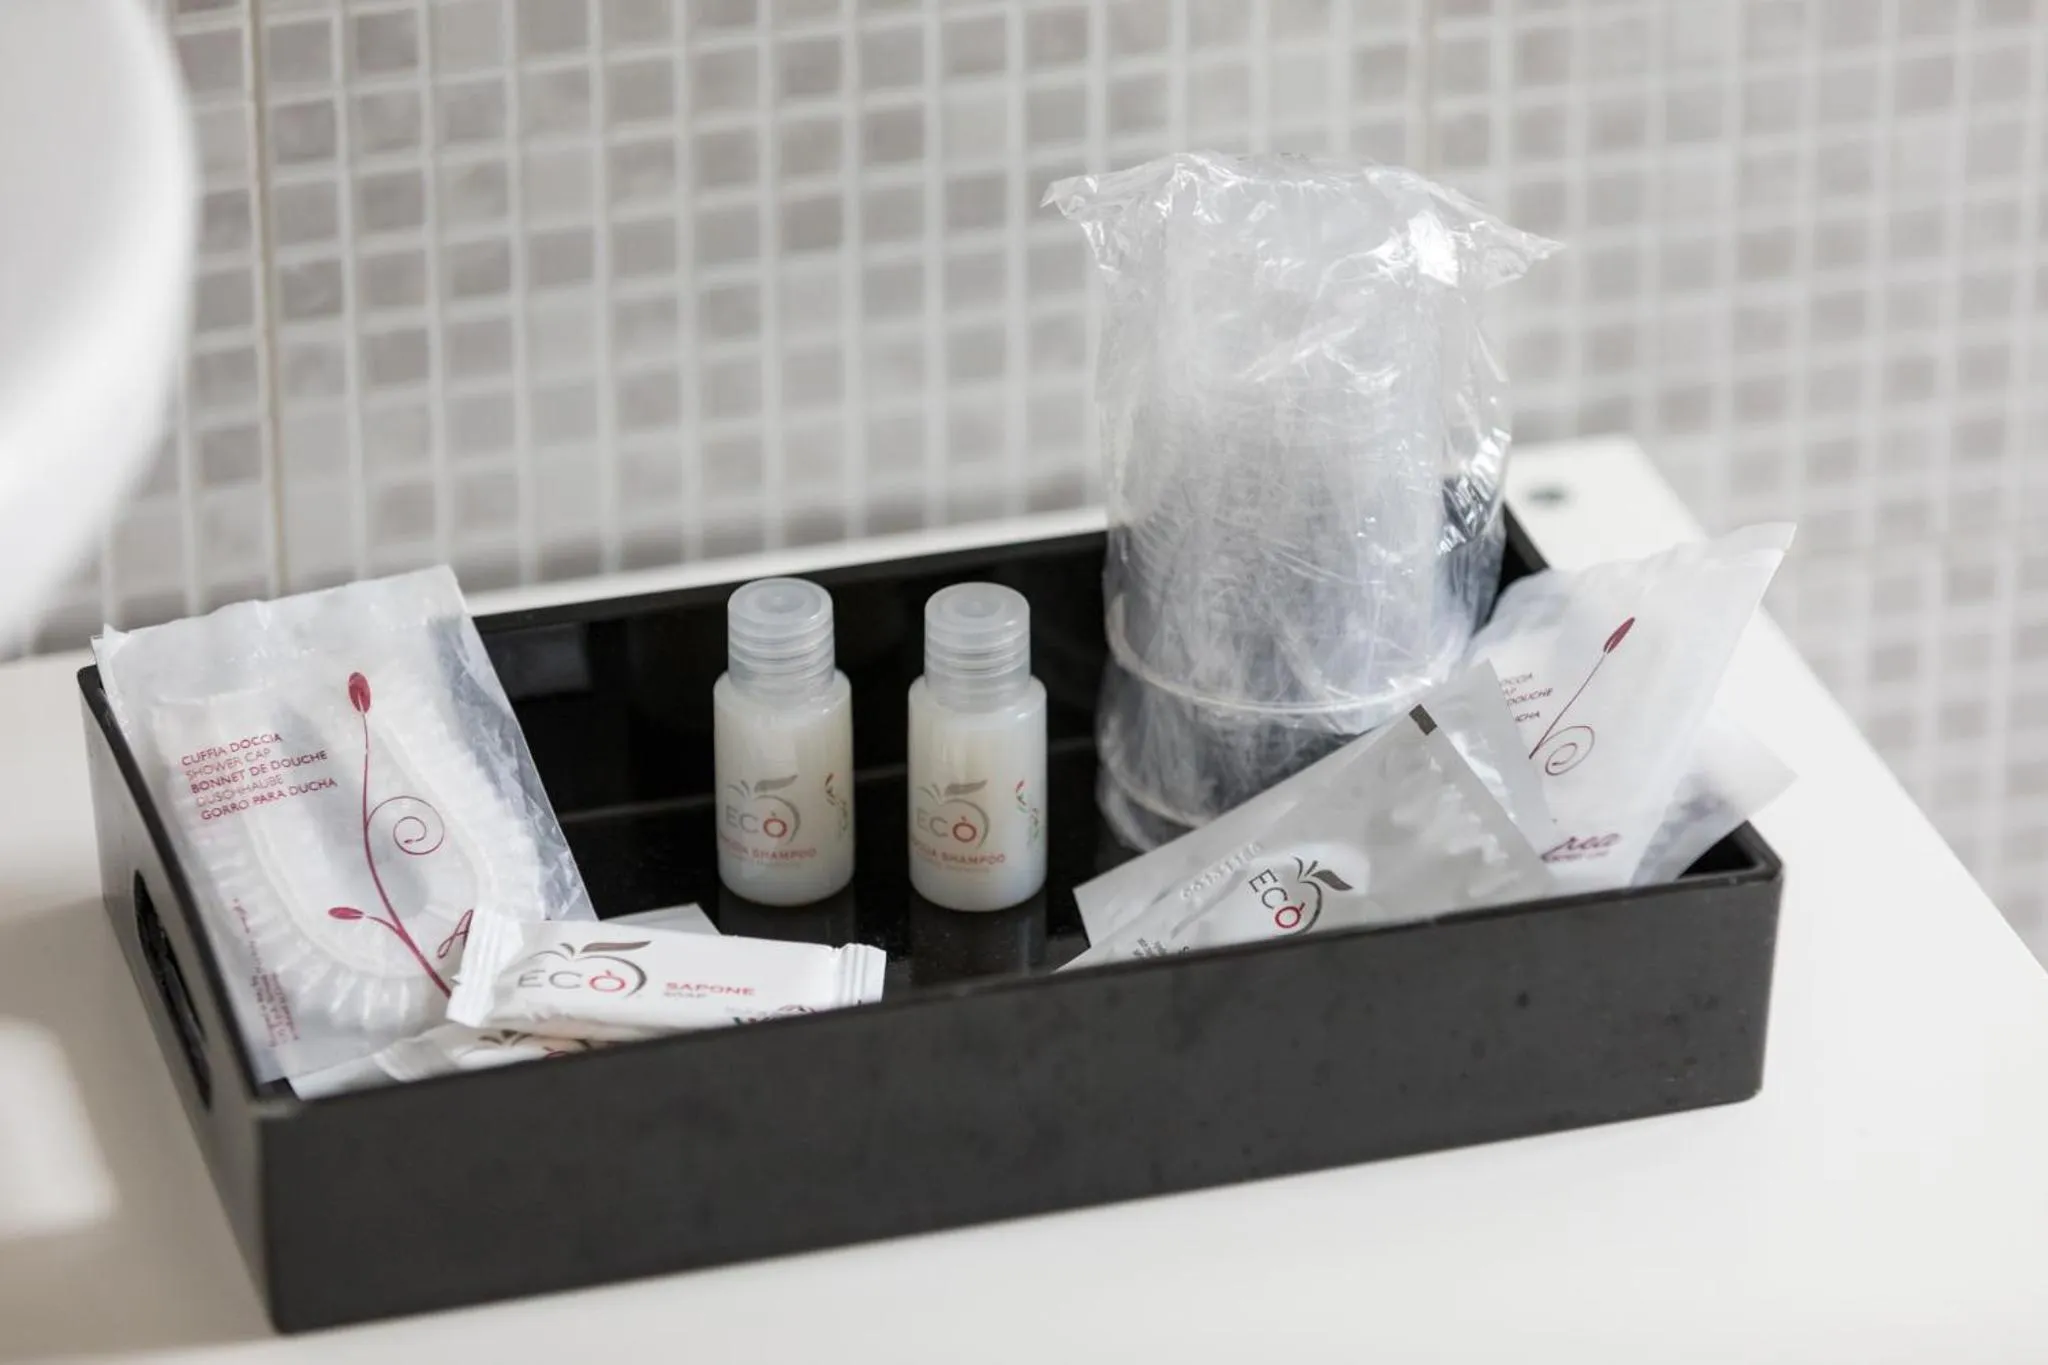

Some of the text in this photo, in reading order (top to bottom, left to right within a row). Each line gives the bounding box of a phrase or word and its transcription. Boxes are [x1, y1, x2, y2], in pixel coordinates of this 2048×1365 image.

[181, 732, 283, 767] CUFFIA DOCCIA
[185, 747, 271, 780] SHOWER CAP
[190, 750, 328, 794] BONNET DE DOUCHE
[201, 776, 338, 821] GORRO PARA DUCHA
[752, 846, 818, 861] SHAMPOO
[940, 852, 1007, 866] SHAMPOO
[664, 981, 756, 997] SAPONE
